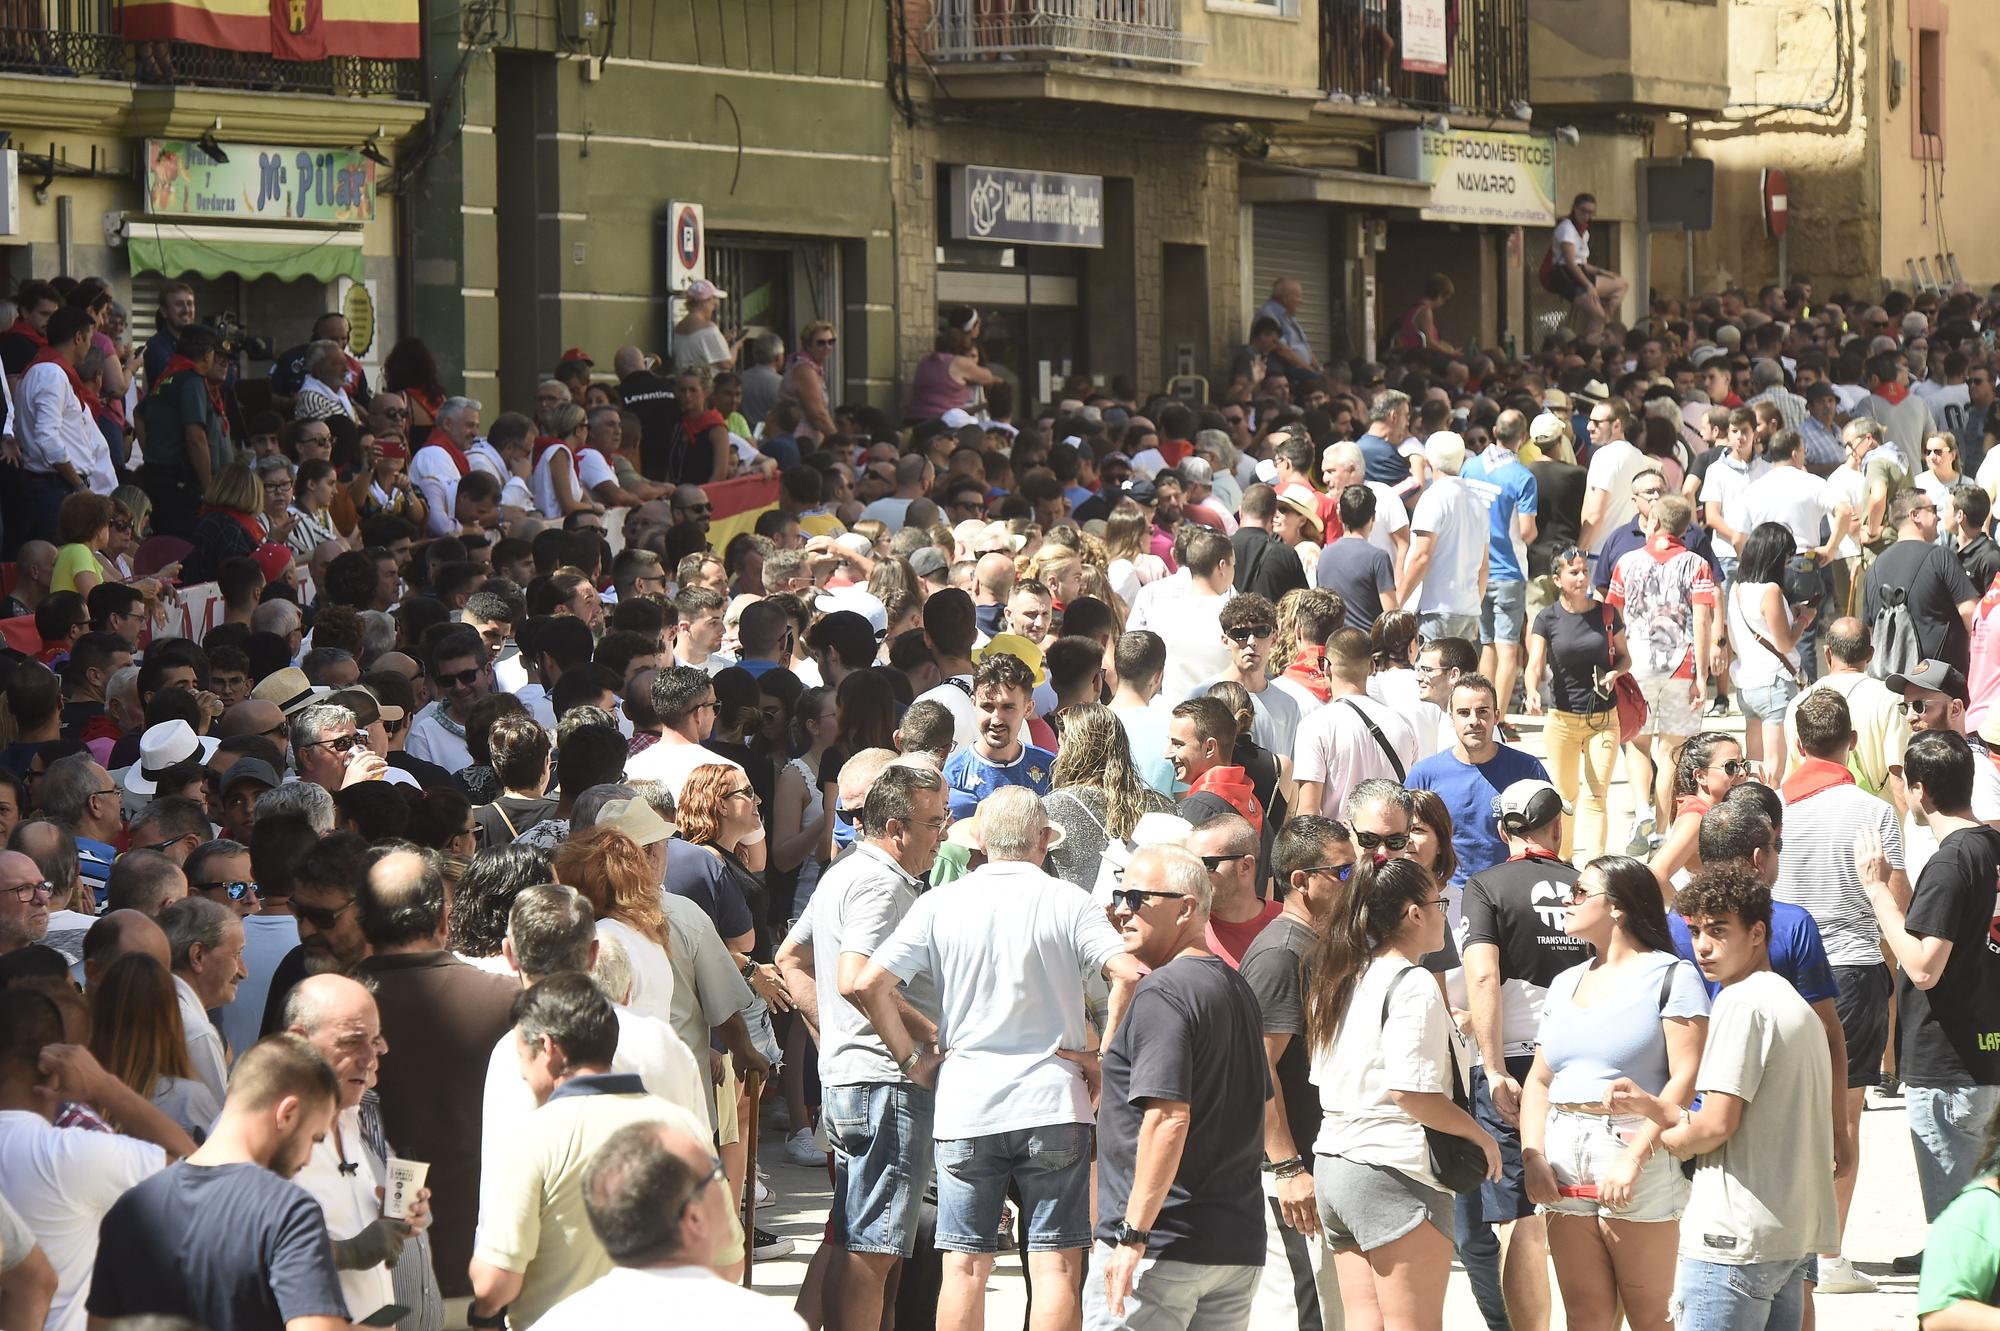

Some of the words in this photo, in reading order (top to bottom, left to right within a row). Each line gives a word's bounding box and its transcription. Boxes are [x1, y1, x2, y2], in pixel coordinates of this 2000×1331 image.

[1423, 136, 1552, 166] ELECTRODOMÉSTICOS
[296, 151, 364, 218] Pilar
[1457, 172, 1516, 194] NAVARRO
[624, 390, 675, 404] Levantina
[1537, 935, 1587, 945] TRANSVULCAN
